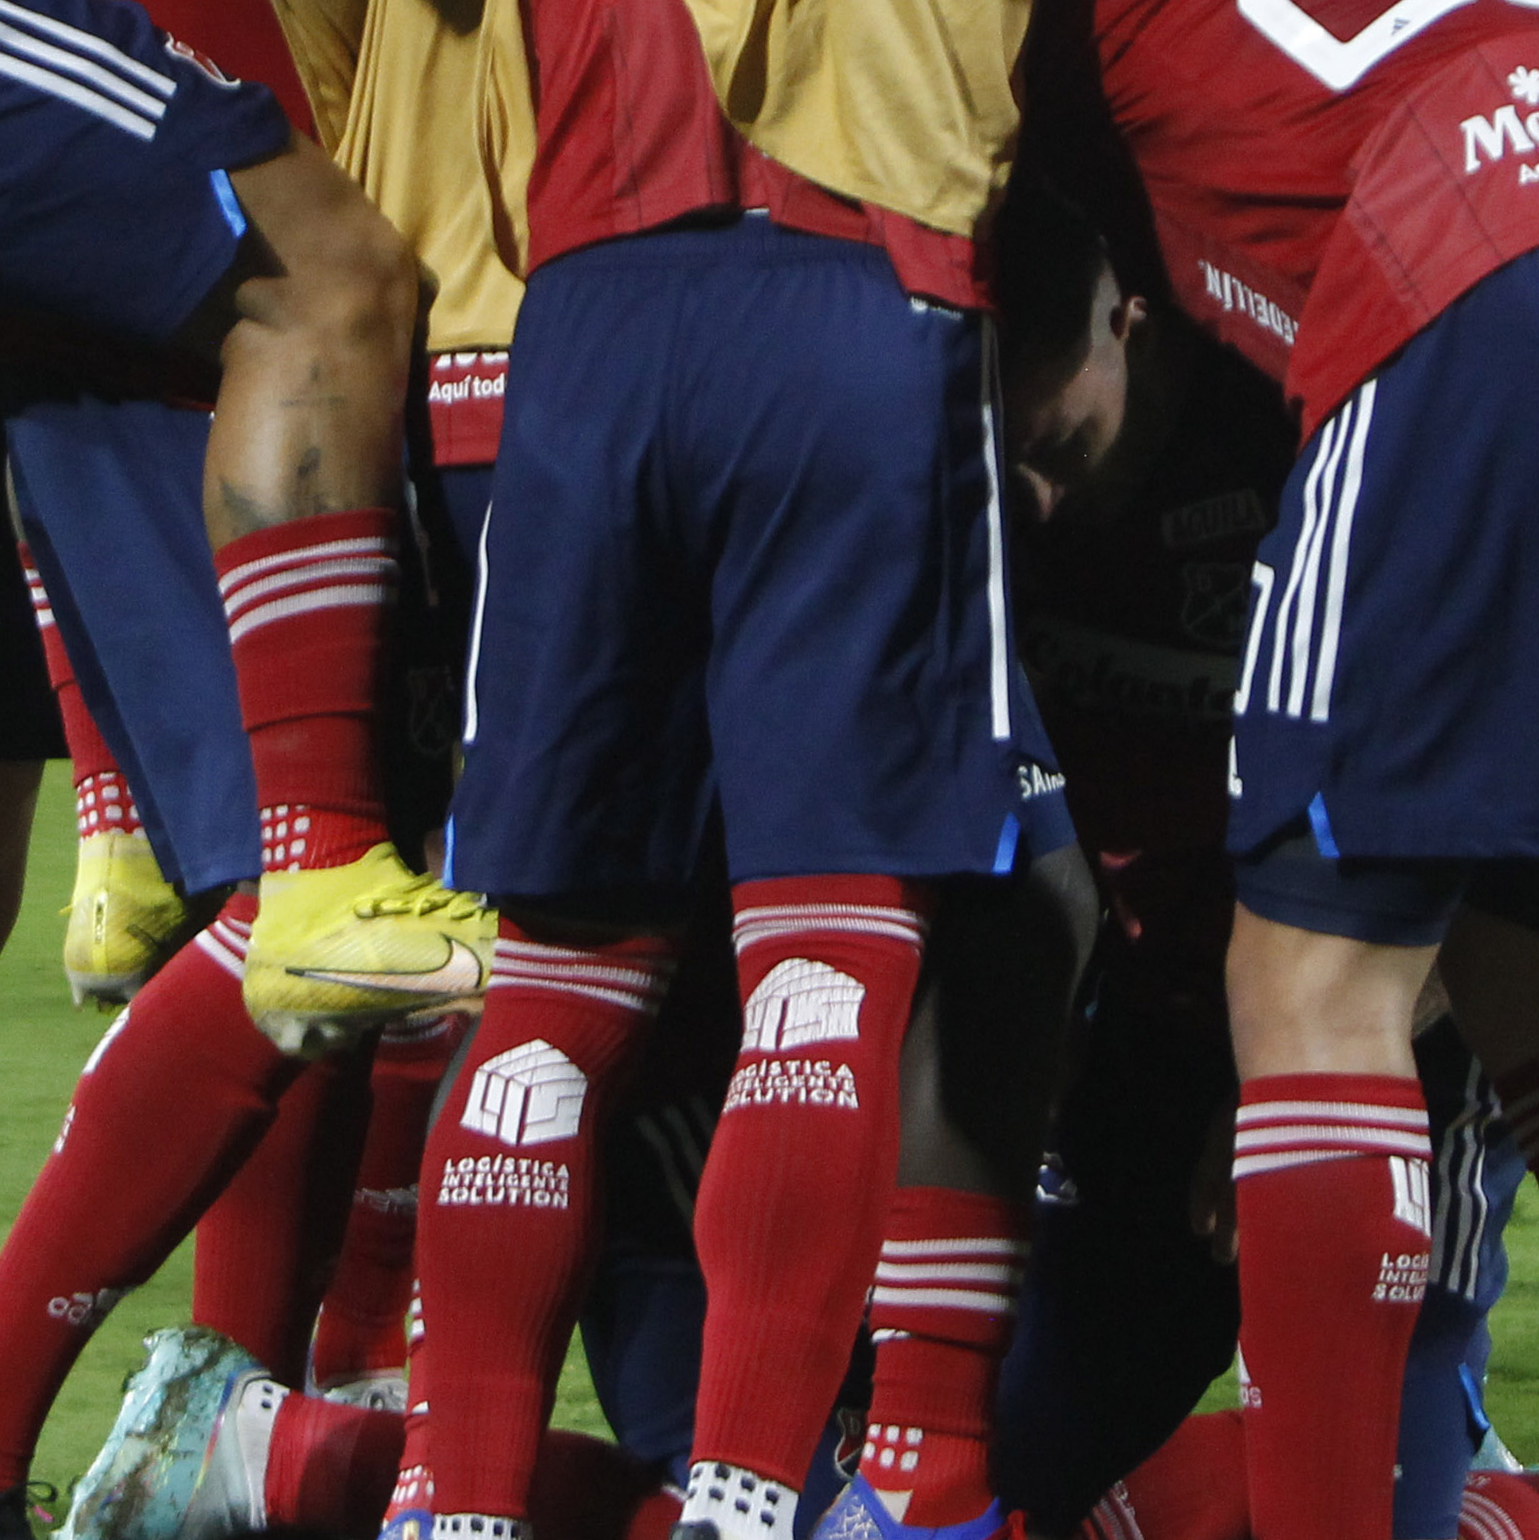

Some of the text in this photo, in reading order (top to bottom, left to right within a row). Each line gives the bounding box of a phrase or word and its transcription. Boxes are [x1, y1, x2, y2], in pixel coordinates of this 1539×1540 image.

[427, 372, 472, 405] Aquí
[443, 1153, 570, 1178] LOGÍSTICA
[437, 1187, 570, 1210] SOLUTION
